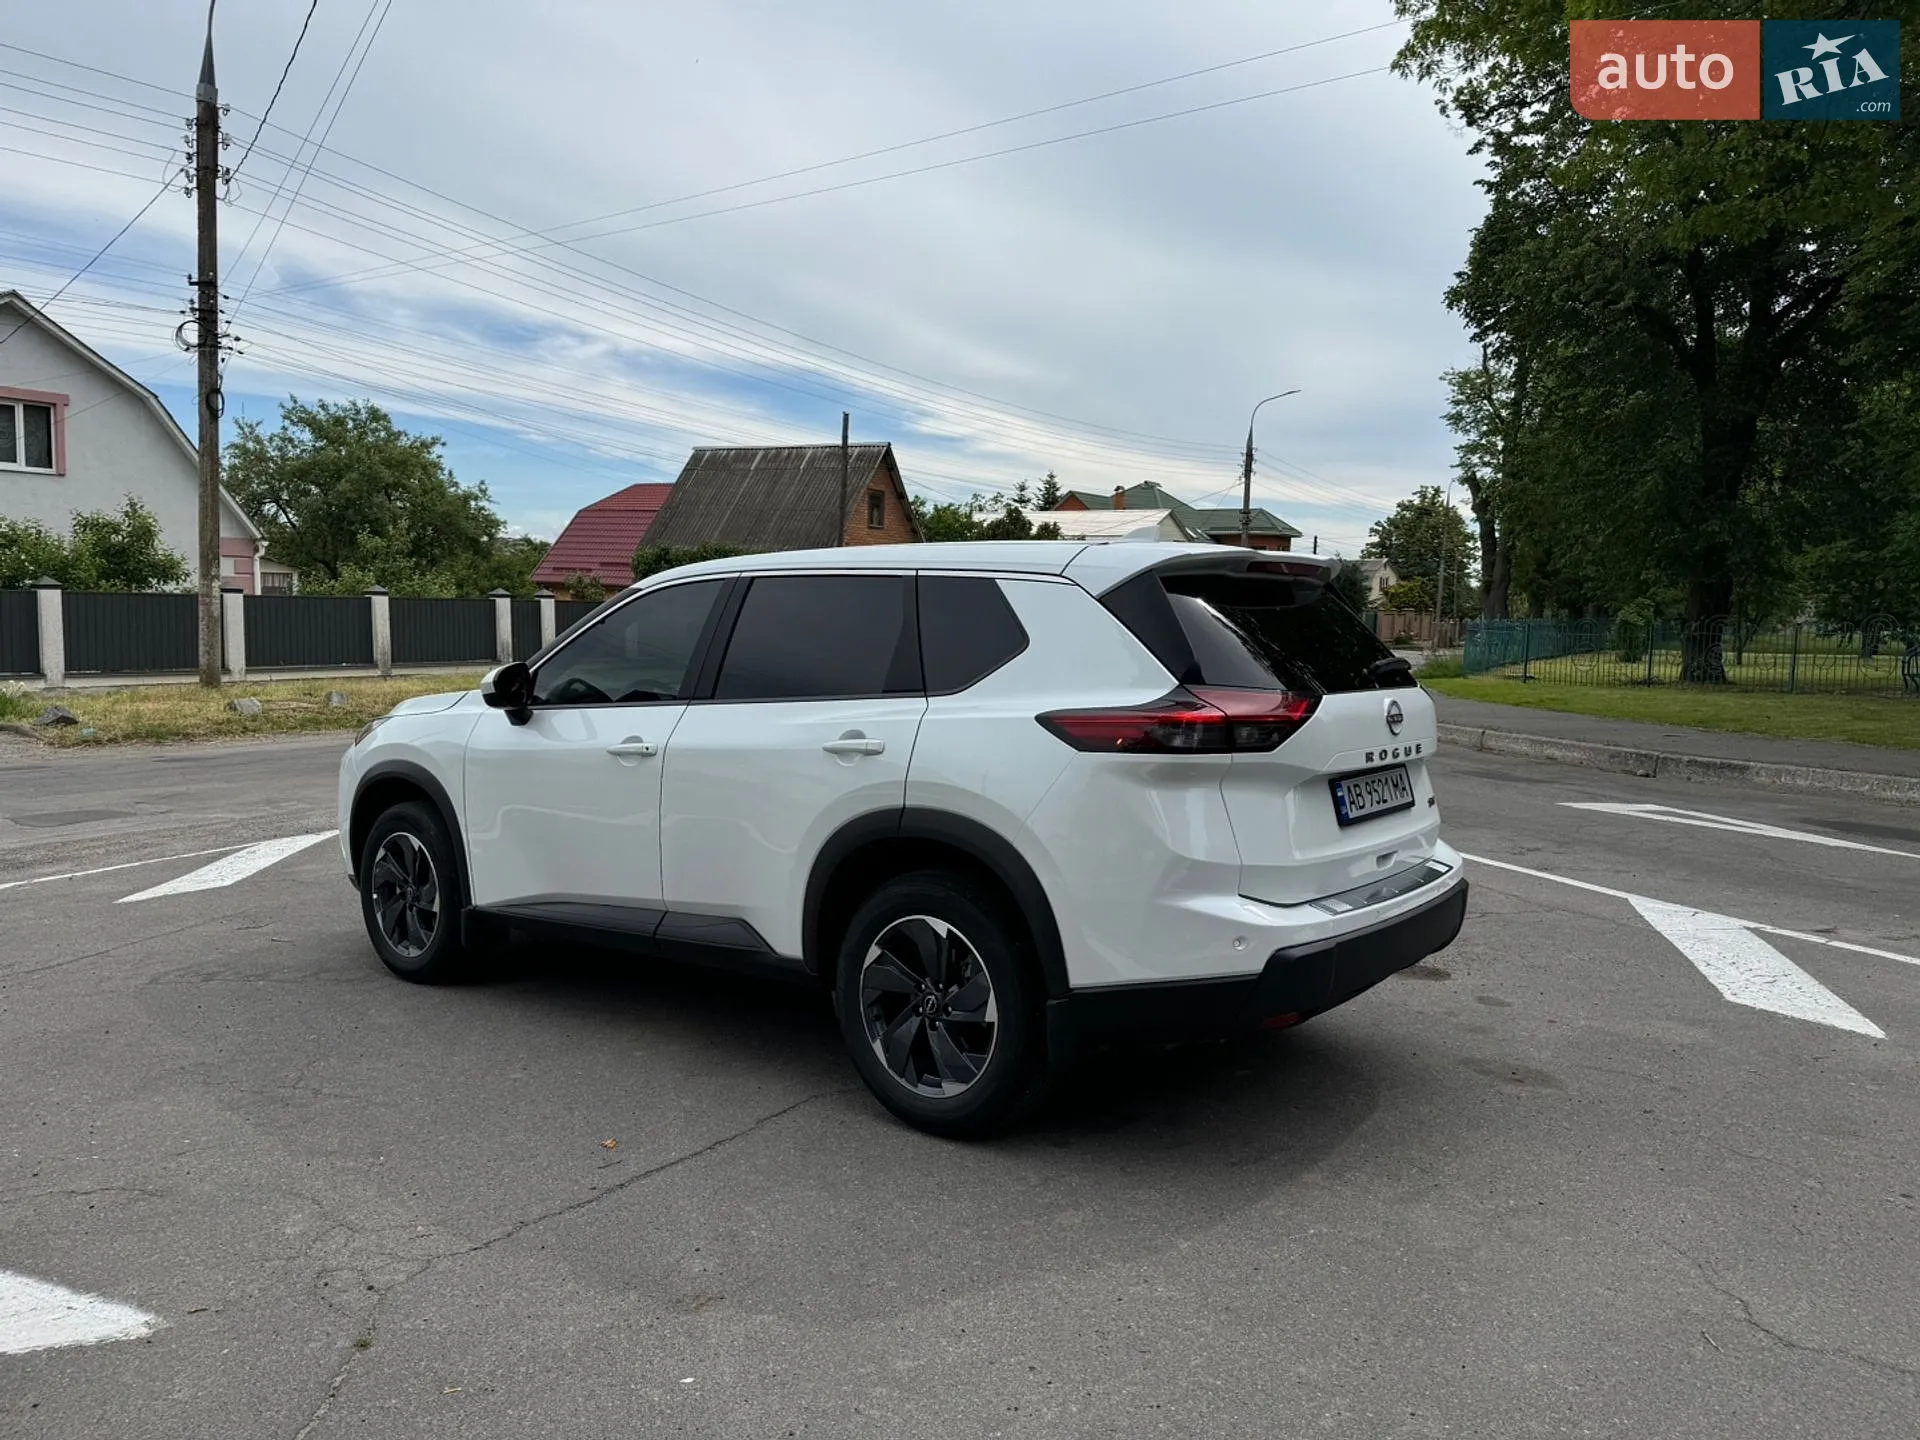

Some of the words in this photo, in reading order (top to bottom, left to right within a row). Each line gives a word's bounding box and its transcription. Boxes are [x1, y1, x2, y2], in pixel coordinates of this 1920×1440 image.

[1365, 743, 1422, 763] ROGUE
[1347, 783, 1366, 813] AB
[1366, 776, 1393, 807] 9521
